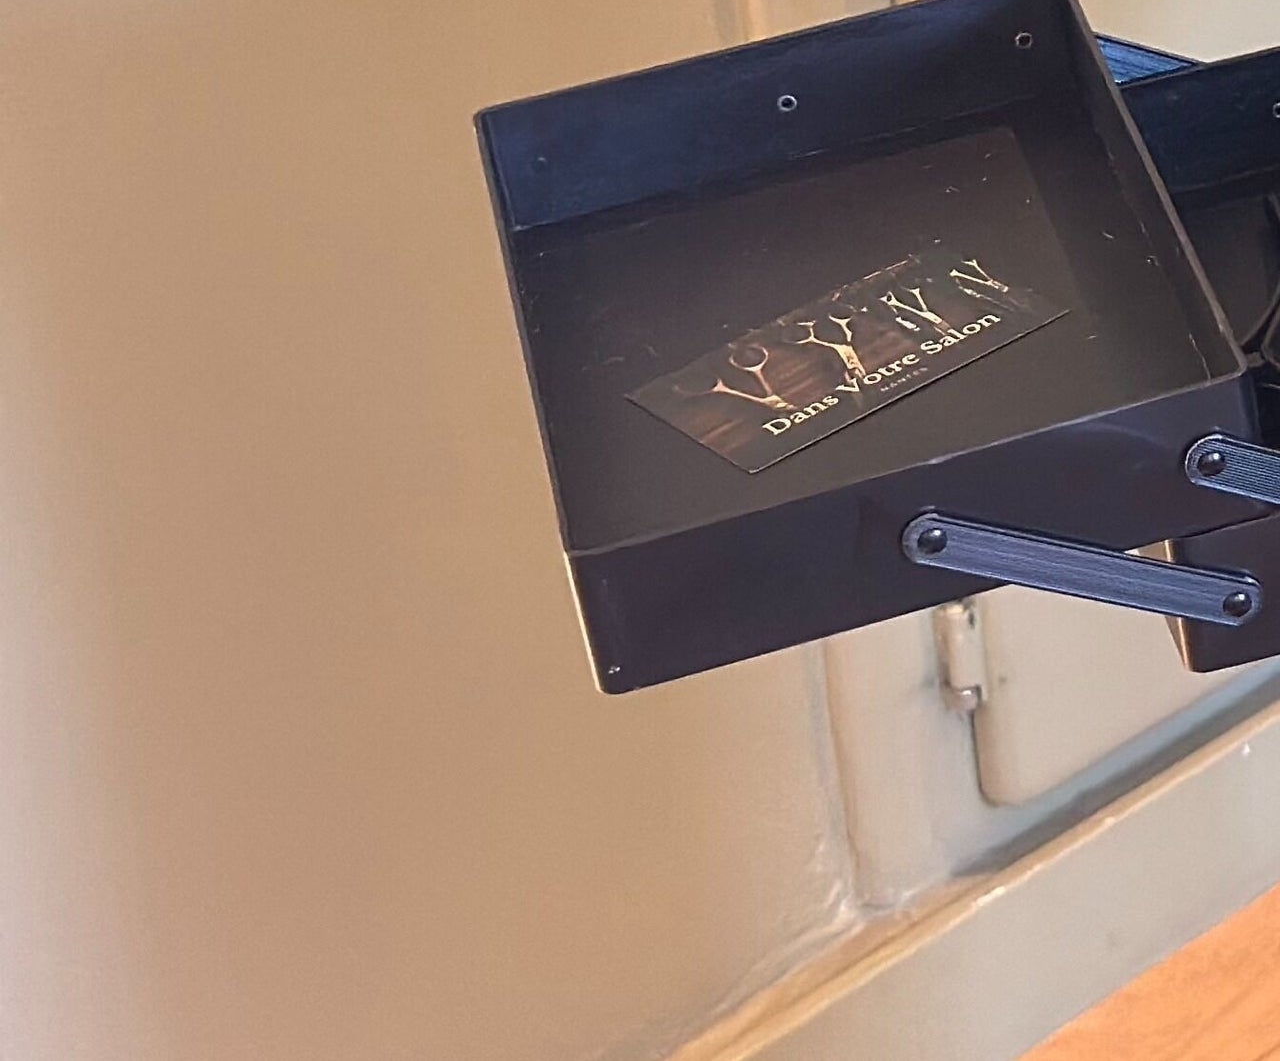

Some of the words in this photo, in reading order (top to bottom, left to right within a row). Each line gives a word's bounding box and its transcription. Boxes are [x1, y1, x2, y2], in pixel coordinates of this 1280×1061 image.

[762, 396, 839, 435] Dans
[835, 354, 920, 392] Votre
[920, 314, 1001, 355] Salon
